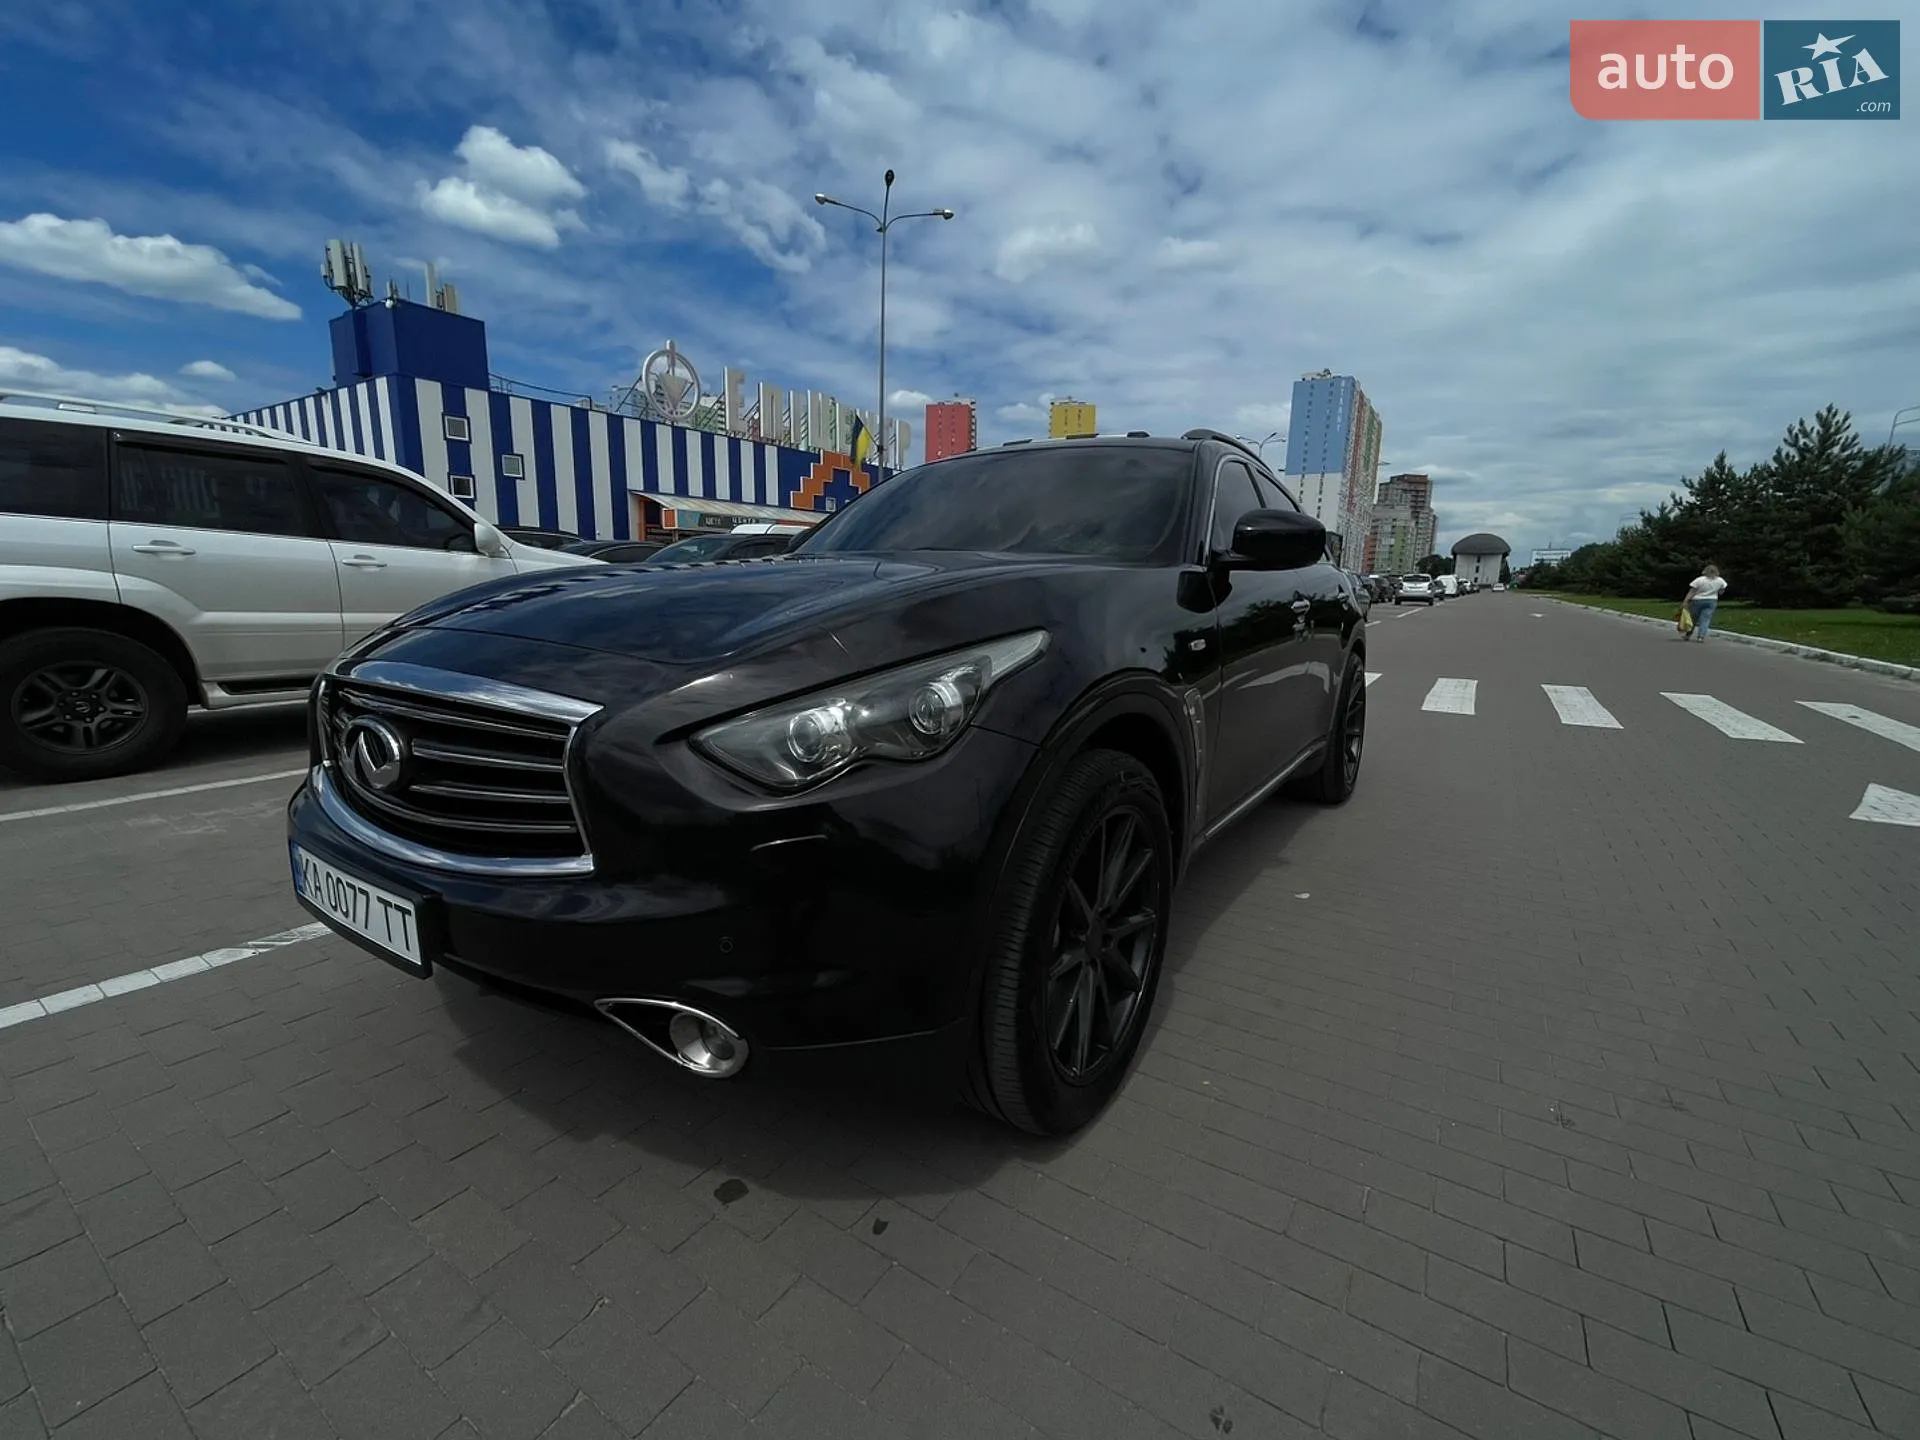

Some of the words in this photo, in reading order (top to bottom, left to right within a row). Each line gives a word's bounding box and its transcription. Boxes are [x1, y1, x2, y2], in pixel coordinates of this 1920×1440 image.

[299, 853, 325, 905] KA
[325, 871, 371, 930] 0077
[377, 895, 412, 952] TT
